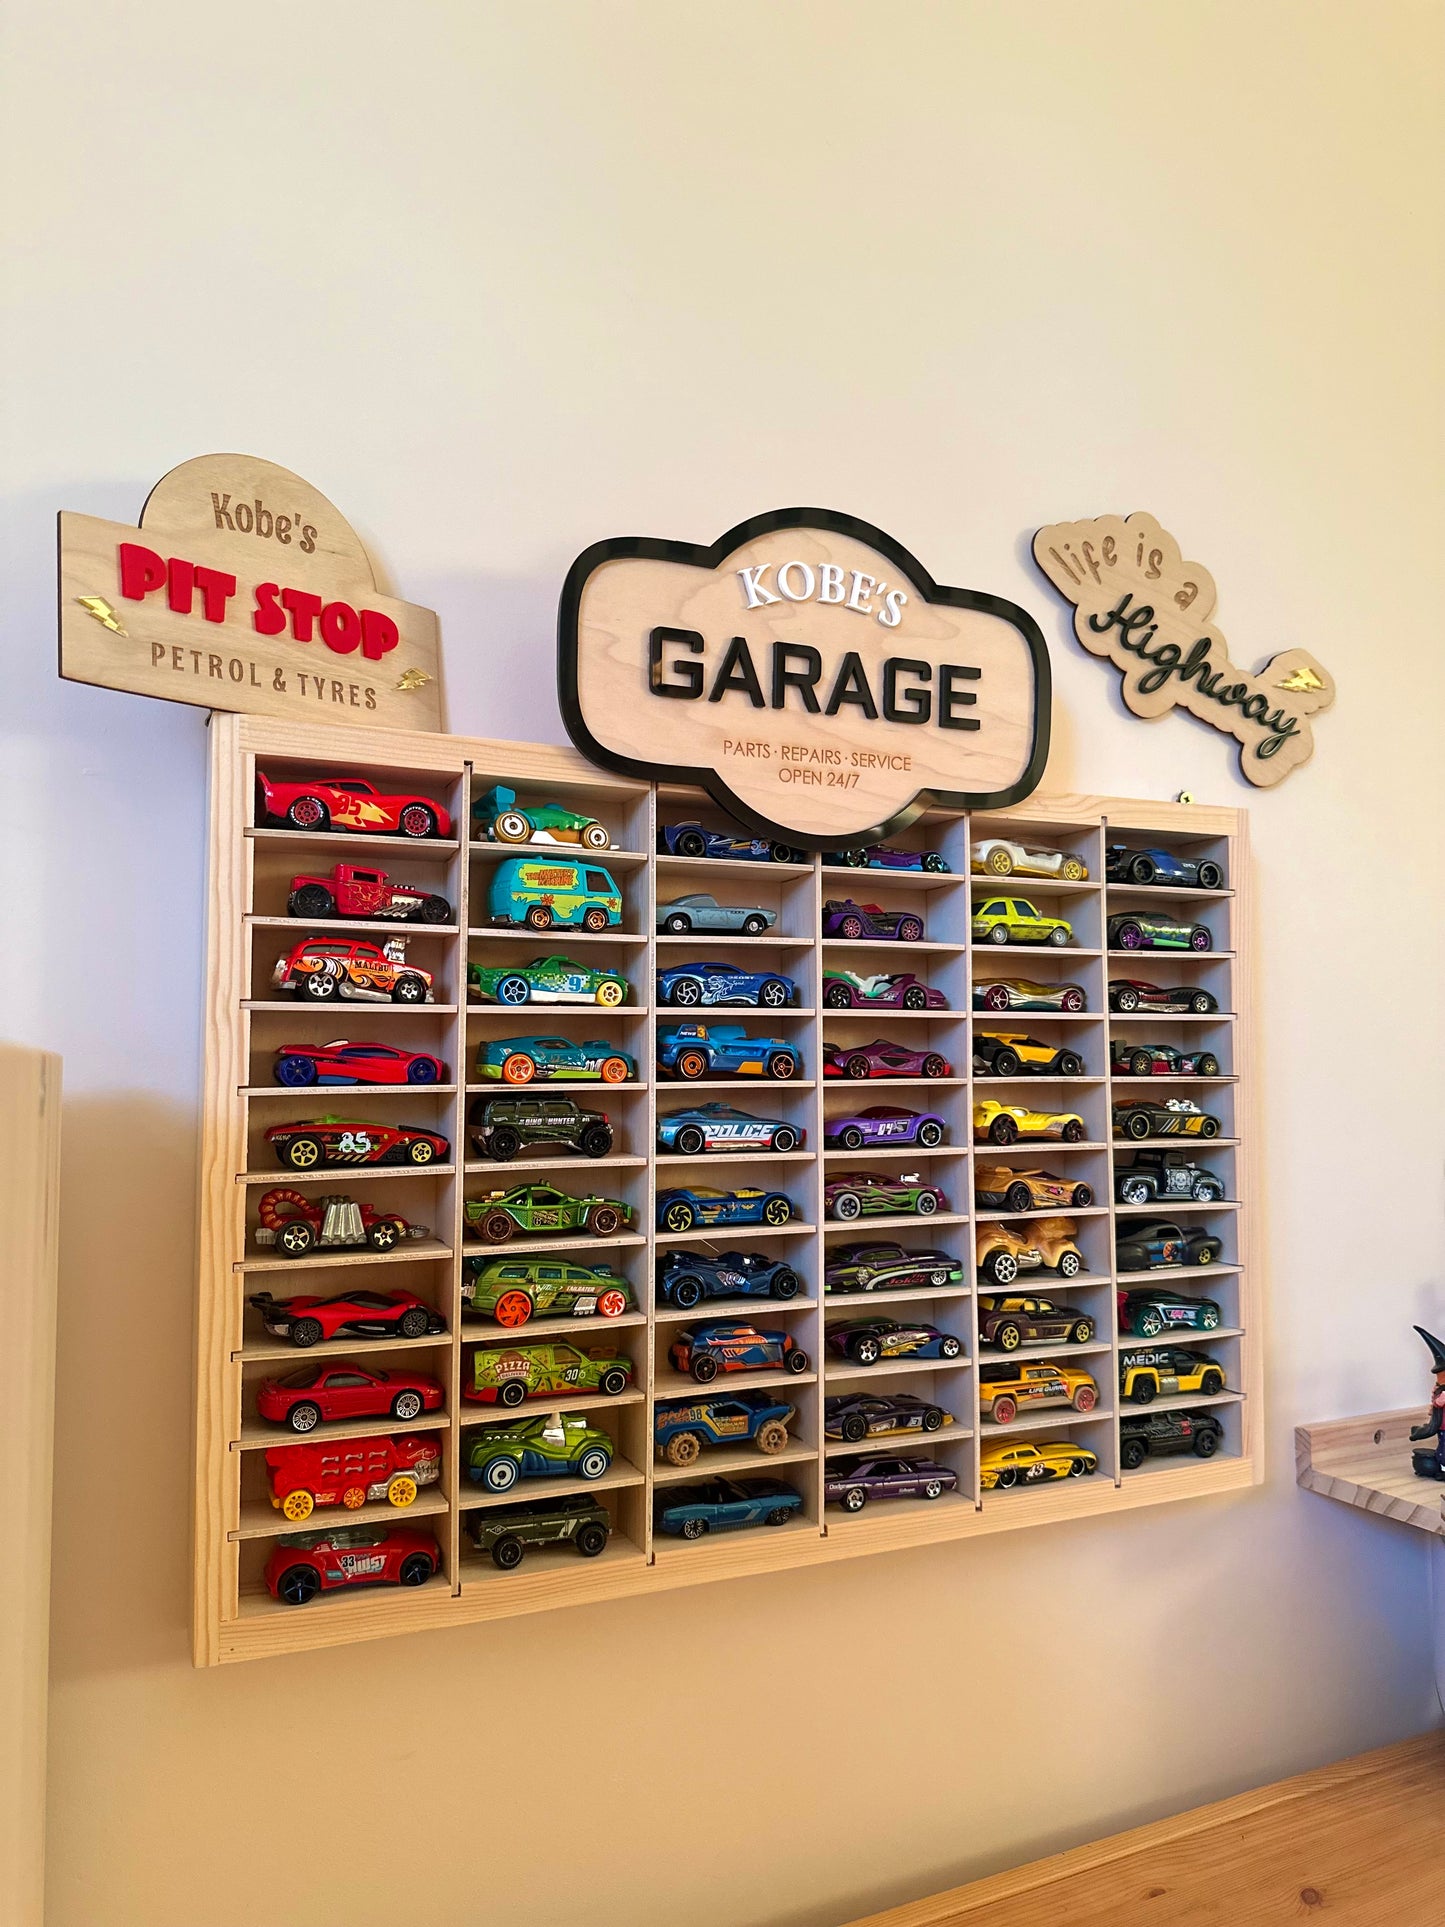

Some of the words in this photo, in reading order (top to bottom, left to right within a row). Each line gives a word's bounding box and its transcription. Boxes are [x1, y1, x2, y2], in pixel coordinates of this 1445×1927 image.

[211, 492, 318, 554] Kobe's
[1049, 536, 1117, 585] life
[1137, 532, 1163, 579] is
[1174, 582, 1198, 611] a
[119, 542, 237, 623] PIT
[254, 582, 400, 661] STOP
[736, 560, 908, 628] KOBE'S
[151, 642, 262, 688] PETROL
[272, 667, 287, 693] &
[297, 673, 378, 710] TYRES
[648, 625, 982, 731] GARAGE
[1089, 593, 1301, 759] Highway
[723, 740, 770, 759] PARTS
[781, 745, 842, 765] REPAIRS
[851, 752, 912, 771] SERVICE
[778, 768, 822, 786] OPEN
[827, 771, 860, 789] 24/7
[568, 977, 581, 992] 9
[709, 1124, 774, 1137] POLICE
[495, 1360, 531, 1373] PIZZA
[565, 1368, 579, 1381] 30
[1123, 1352, 1169, 1366] MEDIC
[341, 1555, 355, 1568] 33
